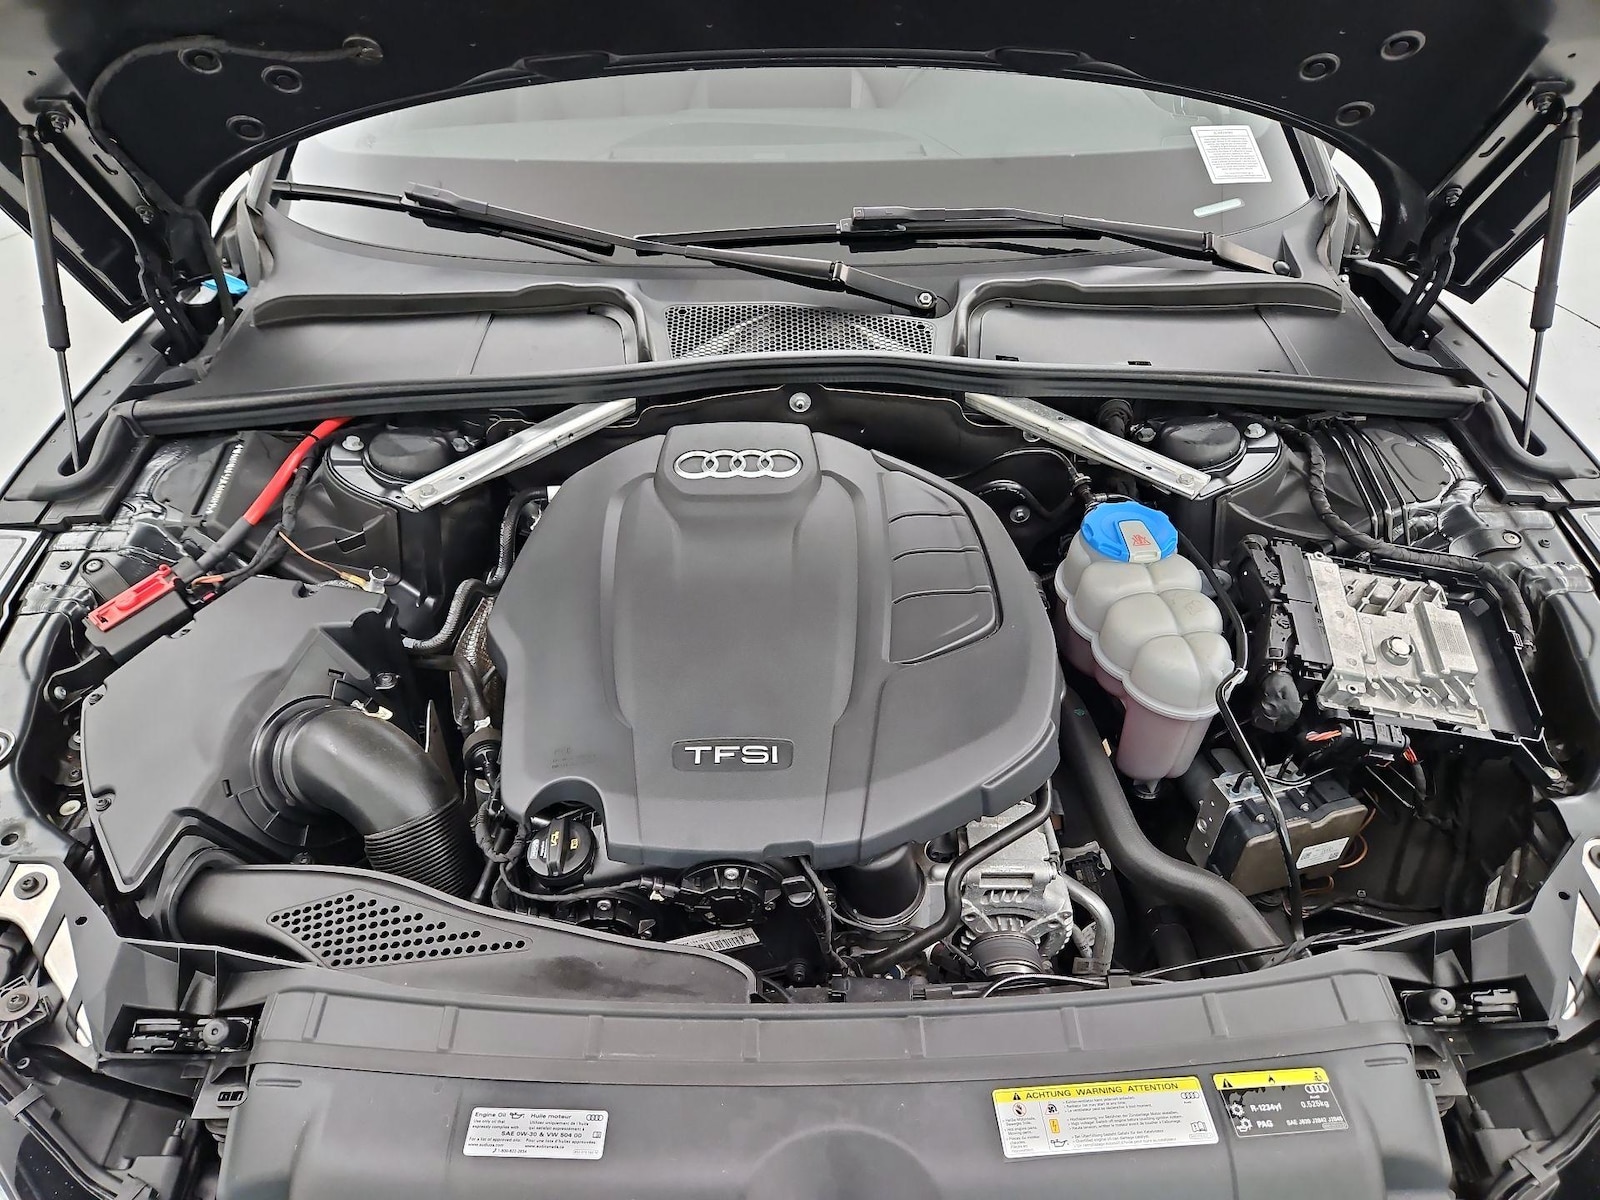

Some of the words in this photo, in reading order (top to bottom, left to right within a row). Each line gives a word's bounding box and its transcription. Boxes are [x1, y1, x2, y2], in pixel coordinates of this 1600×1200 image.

[684, 745, 778, 765] TFSI
[1026, 1090, 1072, 1099] ACHTUNG
[1076, 1086, 1122, 1096] WARNING
[1128, 1082, 1178, 1092] ATTENTION
[1250, 1102, 1282, 1112] R-1234yf
[1300, 1100, 1329, 1108] 0.525kg
[1256, 1120, 1274, 1128] PAG
